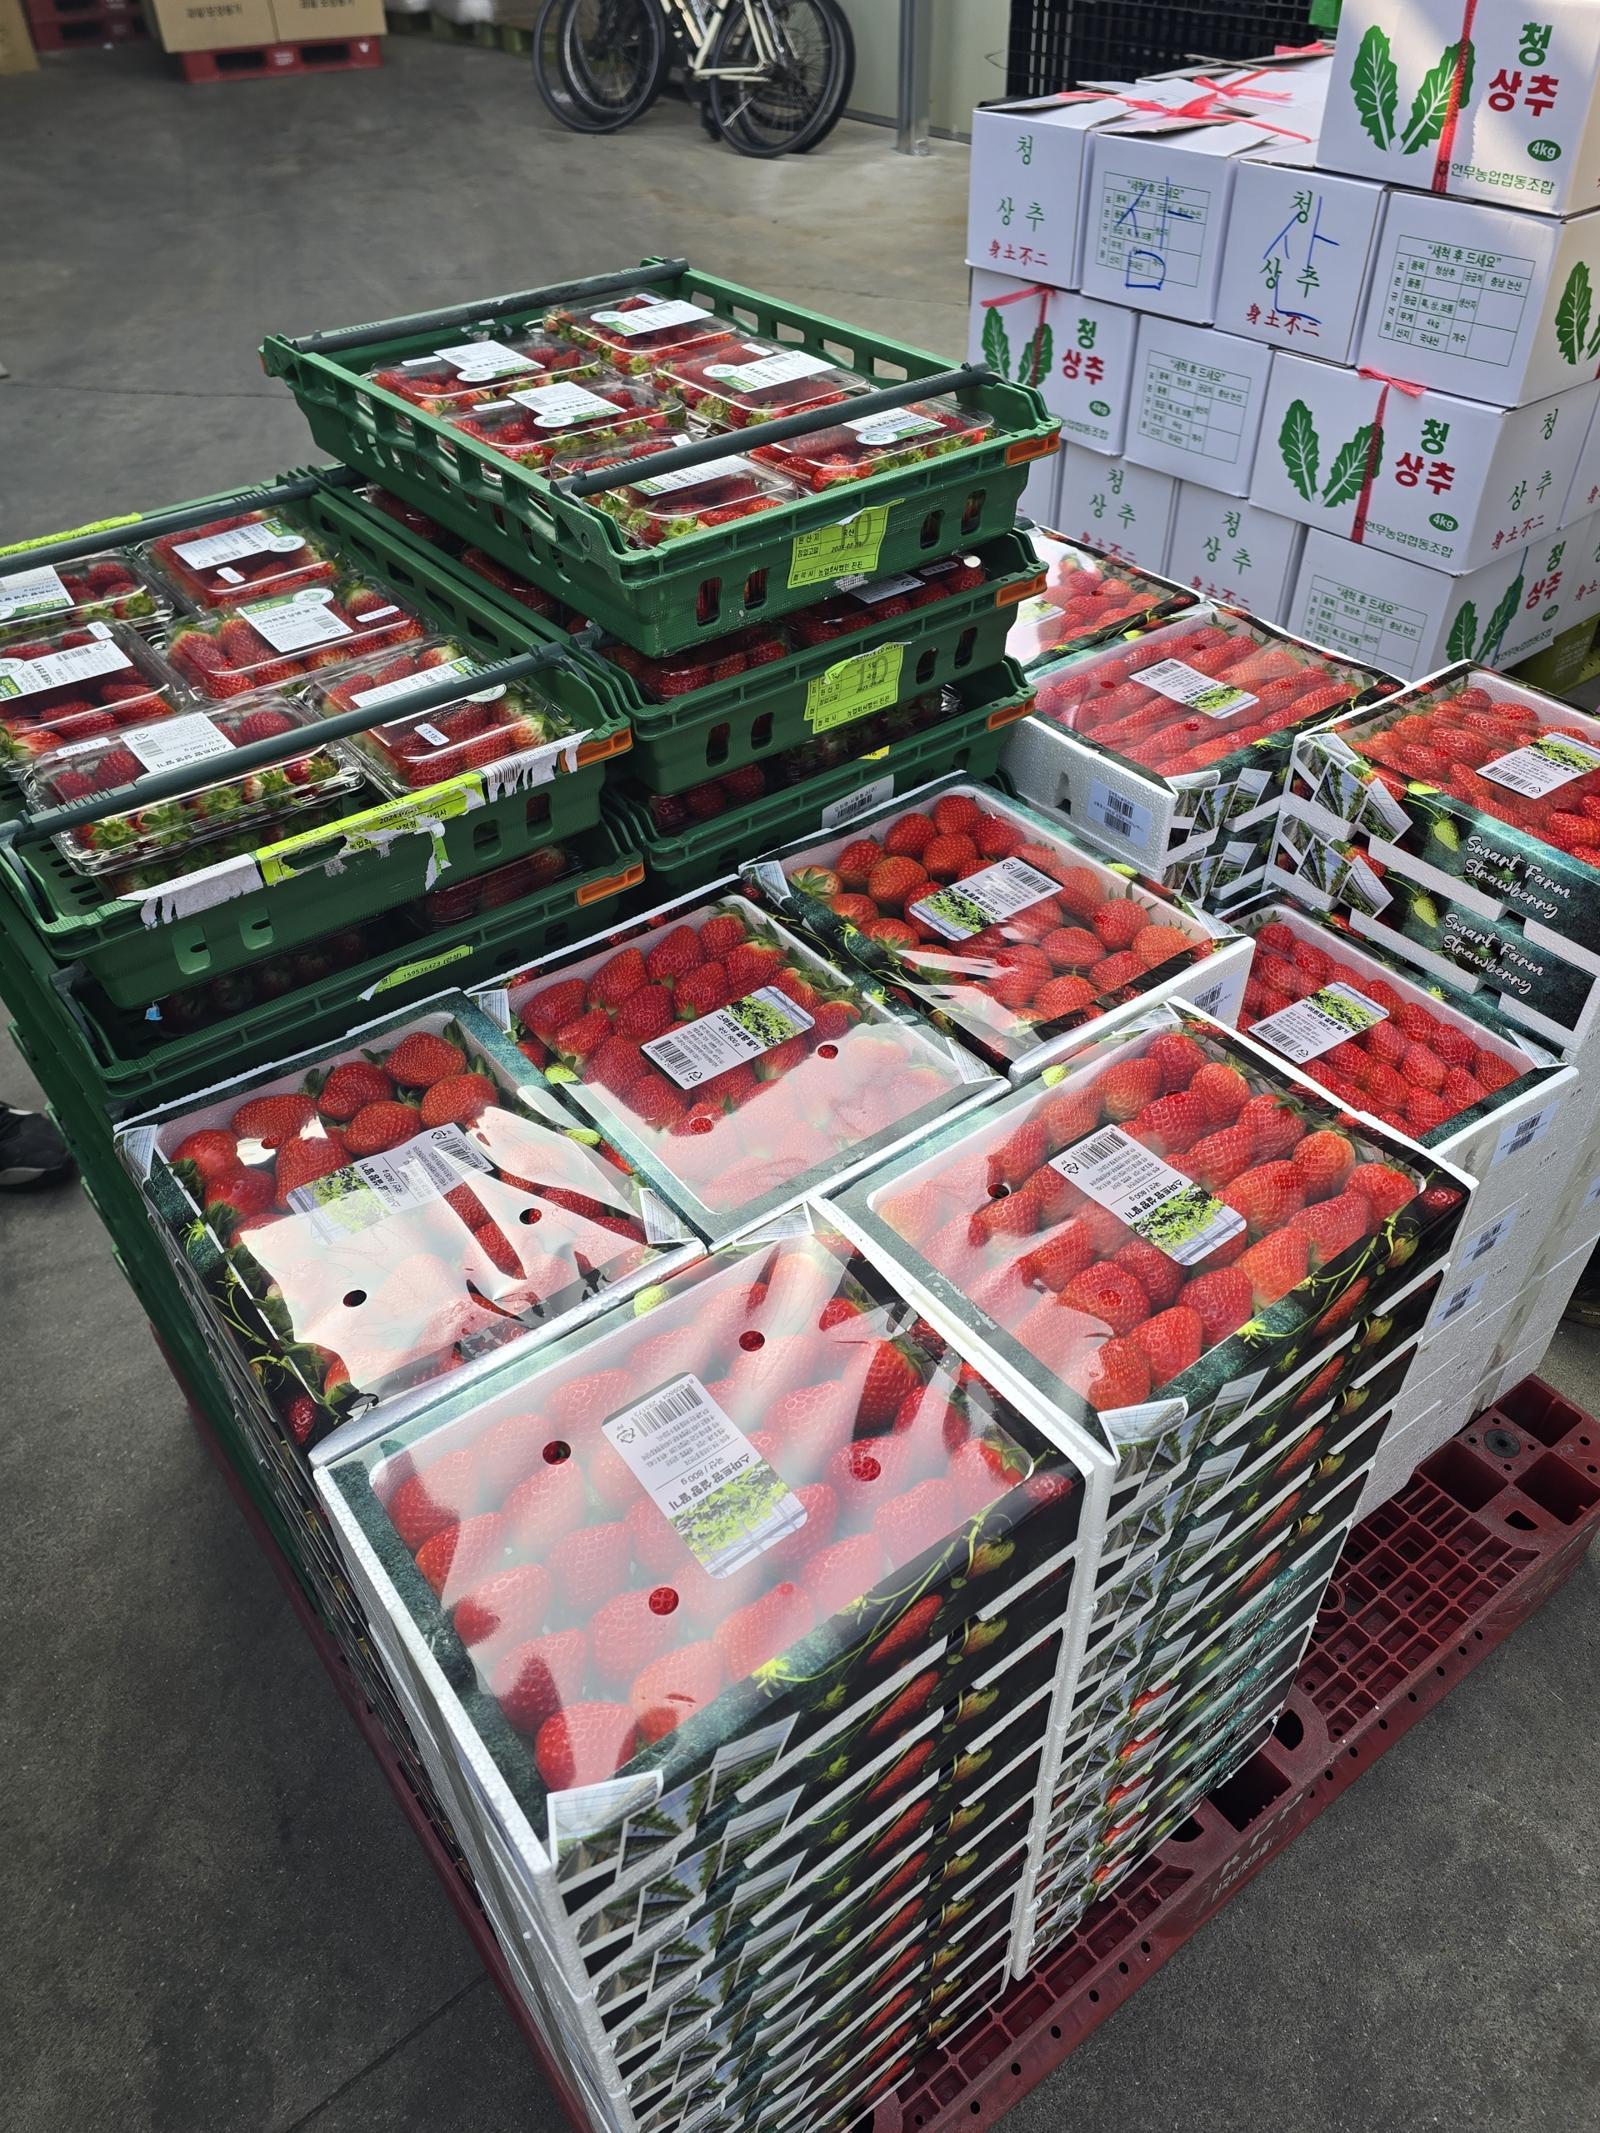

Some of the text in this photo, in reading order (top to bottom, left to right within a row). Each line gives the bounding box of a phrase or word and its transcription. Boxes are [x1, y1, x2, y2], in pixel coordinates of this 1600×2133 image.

[1518, 21, 1553, 67] 청
[1487, 68, 1560, 118] 상추
[1016, 135, 1034, 165] 청
[1531, 142, 1557, 159] 4kg
[1451, 161, 1556, 196] 연무농업협동조합
[1289, 190, 1313, 224] 청
[988, 239, 1049, 266] 身土不二
[1451, 248, 1464, 263] 후
[1077, 318, 1098, 350] 청
[1062, 348, 1105, 386] 상추
[1420, 417, 1451, 456] 청
[1107, 468, 1124, 495] 청
[1395, 451, 1456, 497] 상추
[1223, 510, 1241, 539] 청
[1432, 514, 1456, 531] 4kg
[1546, 540, 1567, 573] 청
[1525, 571, 1563, 611] 상추
[1466, 835, 1571, 901] Smart Farm
[1464, 858, 1559, 920] Strawberry
[1443, 912, 1545, 978] Smart Farm
[1441, 934, 1532, 996] Strawberry
[1122, 1177, 1186, 1220] 스마트팜 설향 딸기
[1146, 1180, 1162, 1191] 국산
[685, 1467, 705, 1483] 800
[705, 1454, 725, 1471] 국산
[667, 1451, 753, 1512] 스마트팜 설향 딸기
[678, 1476, 689, 1486] g
